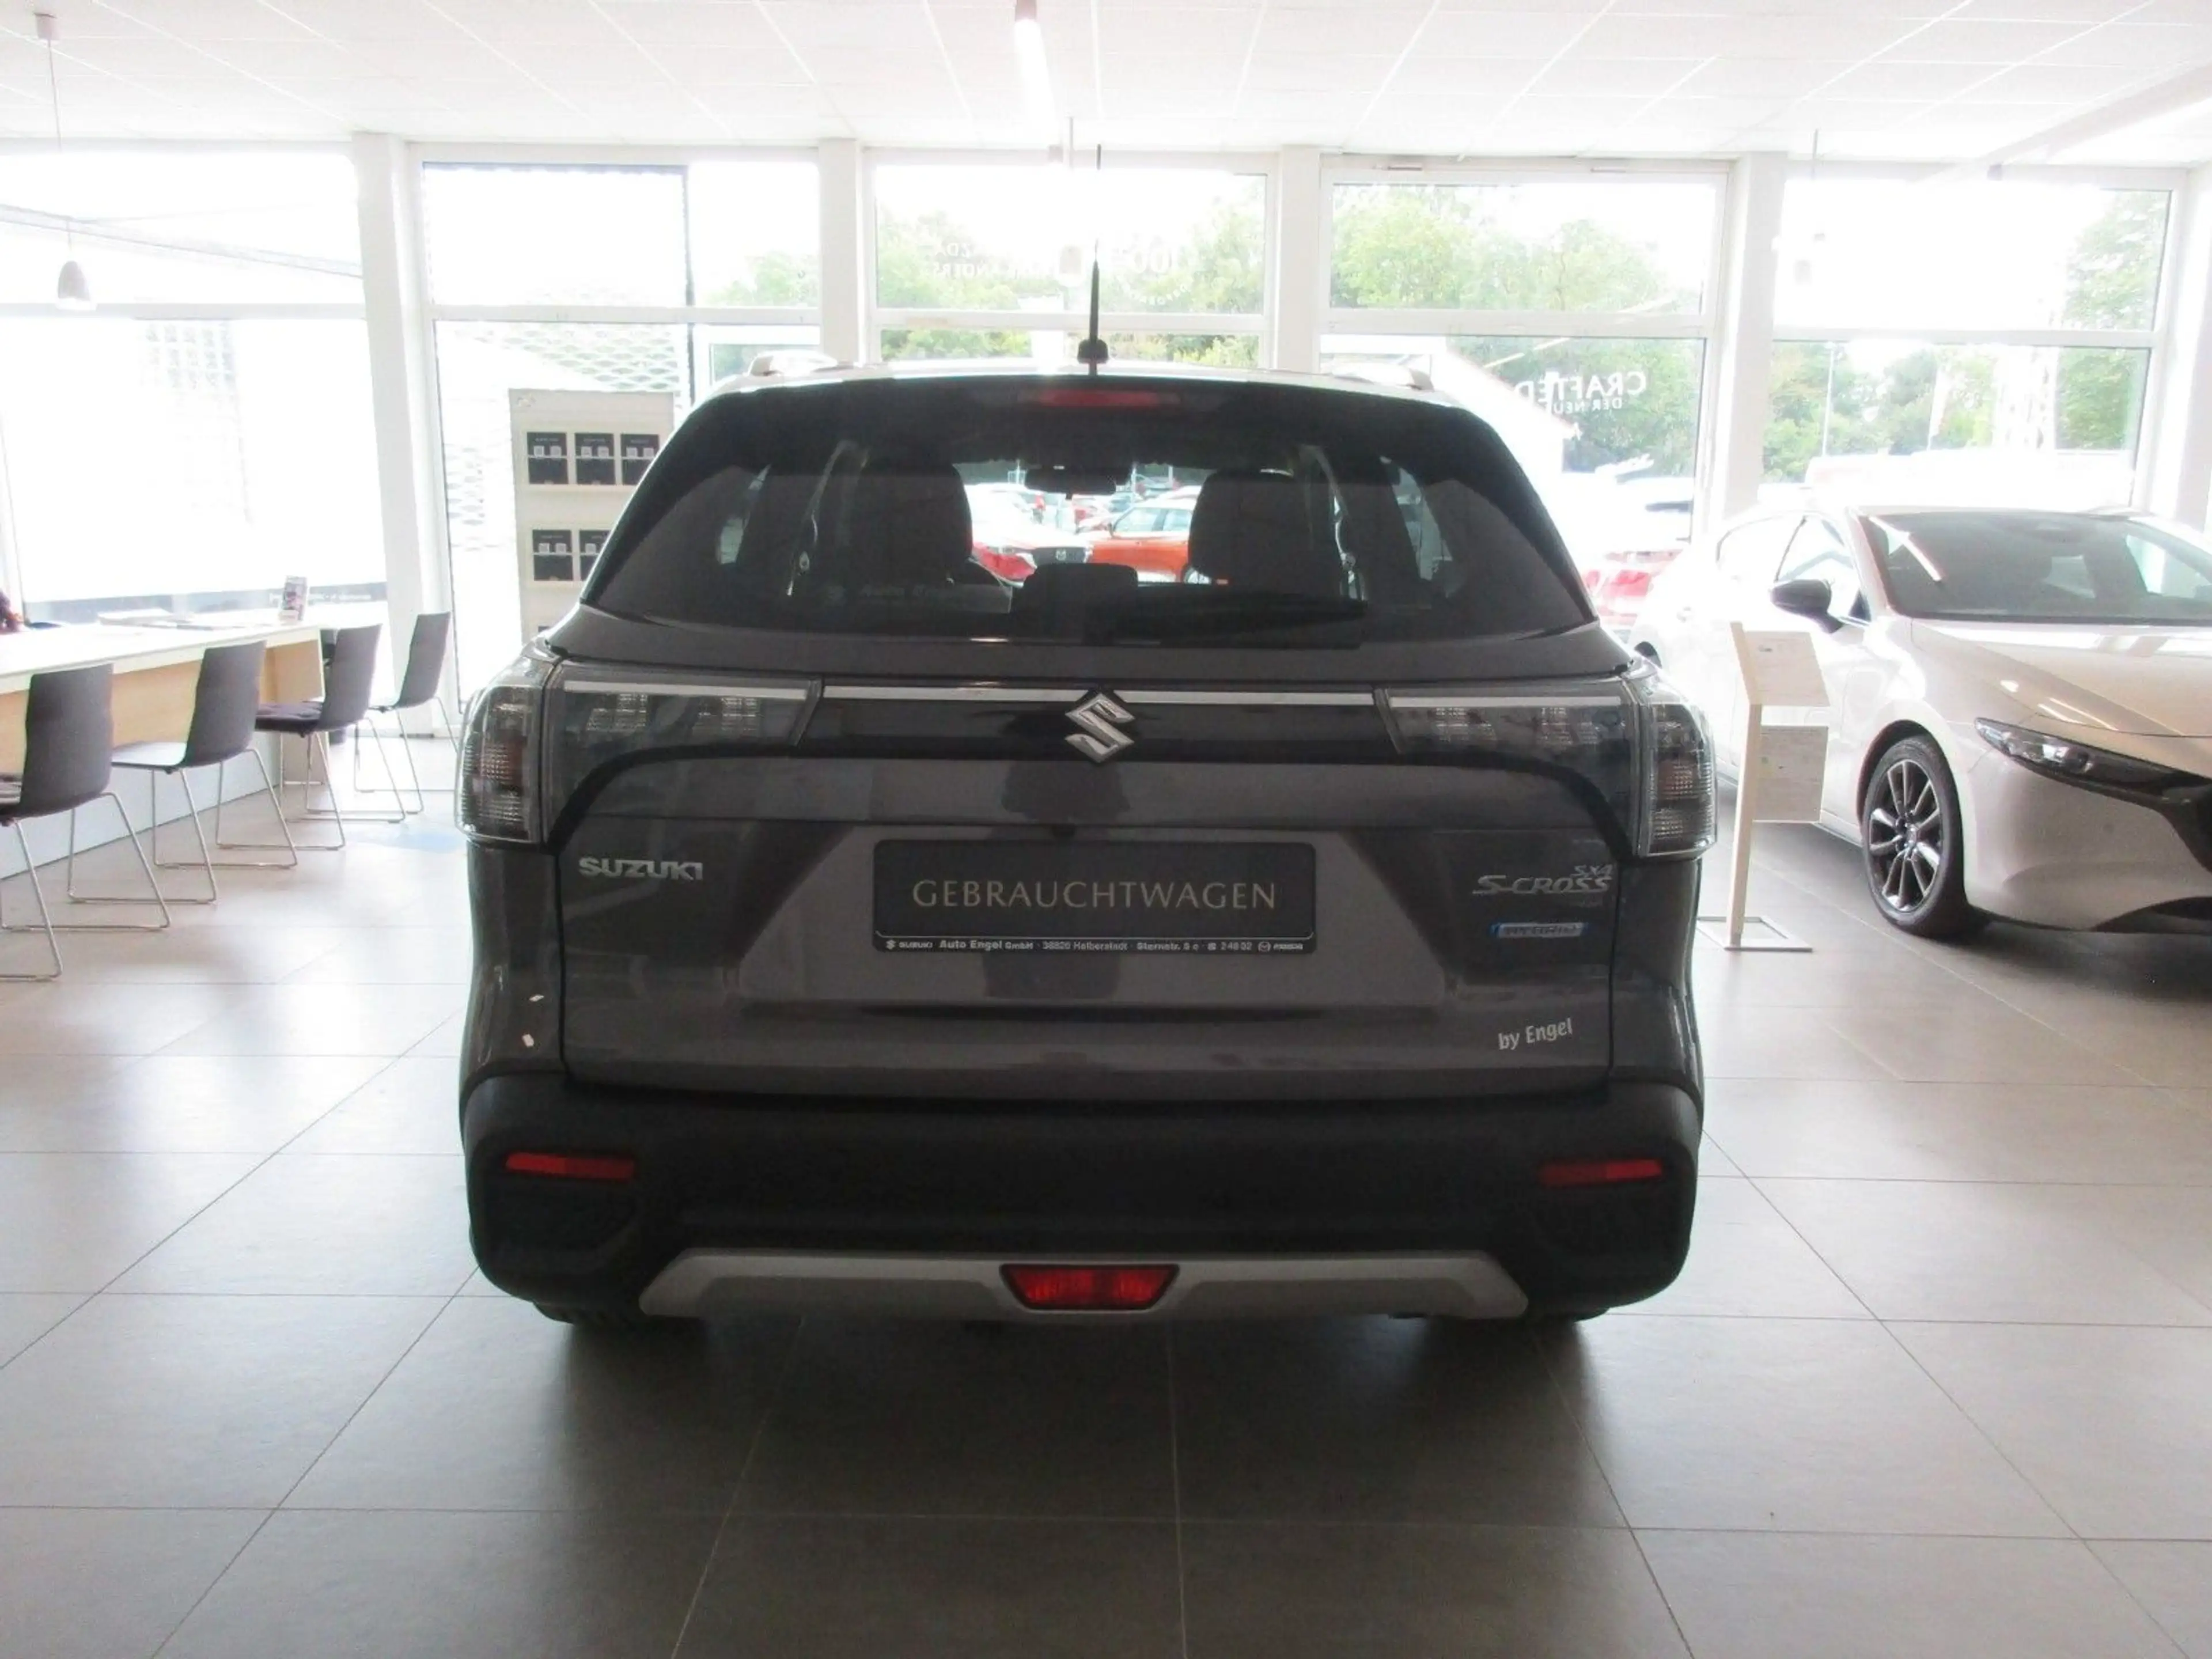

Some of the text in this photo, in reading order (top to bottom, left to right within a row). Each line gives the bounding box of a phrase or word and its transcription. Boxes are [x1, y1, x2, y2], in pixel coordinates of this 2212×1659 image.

[578, 856, 703, 881] SUZUKI
[912, 880, 1276, 909] GEBRAUCHTWAGEN
[940, 940, 966, 949] Auto
[970, 940, 1002, 952] Engel
[1074, 941, 1128, 950] Halberstadt
[1497, 1017, 1573, 1050] by Engel
